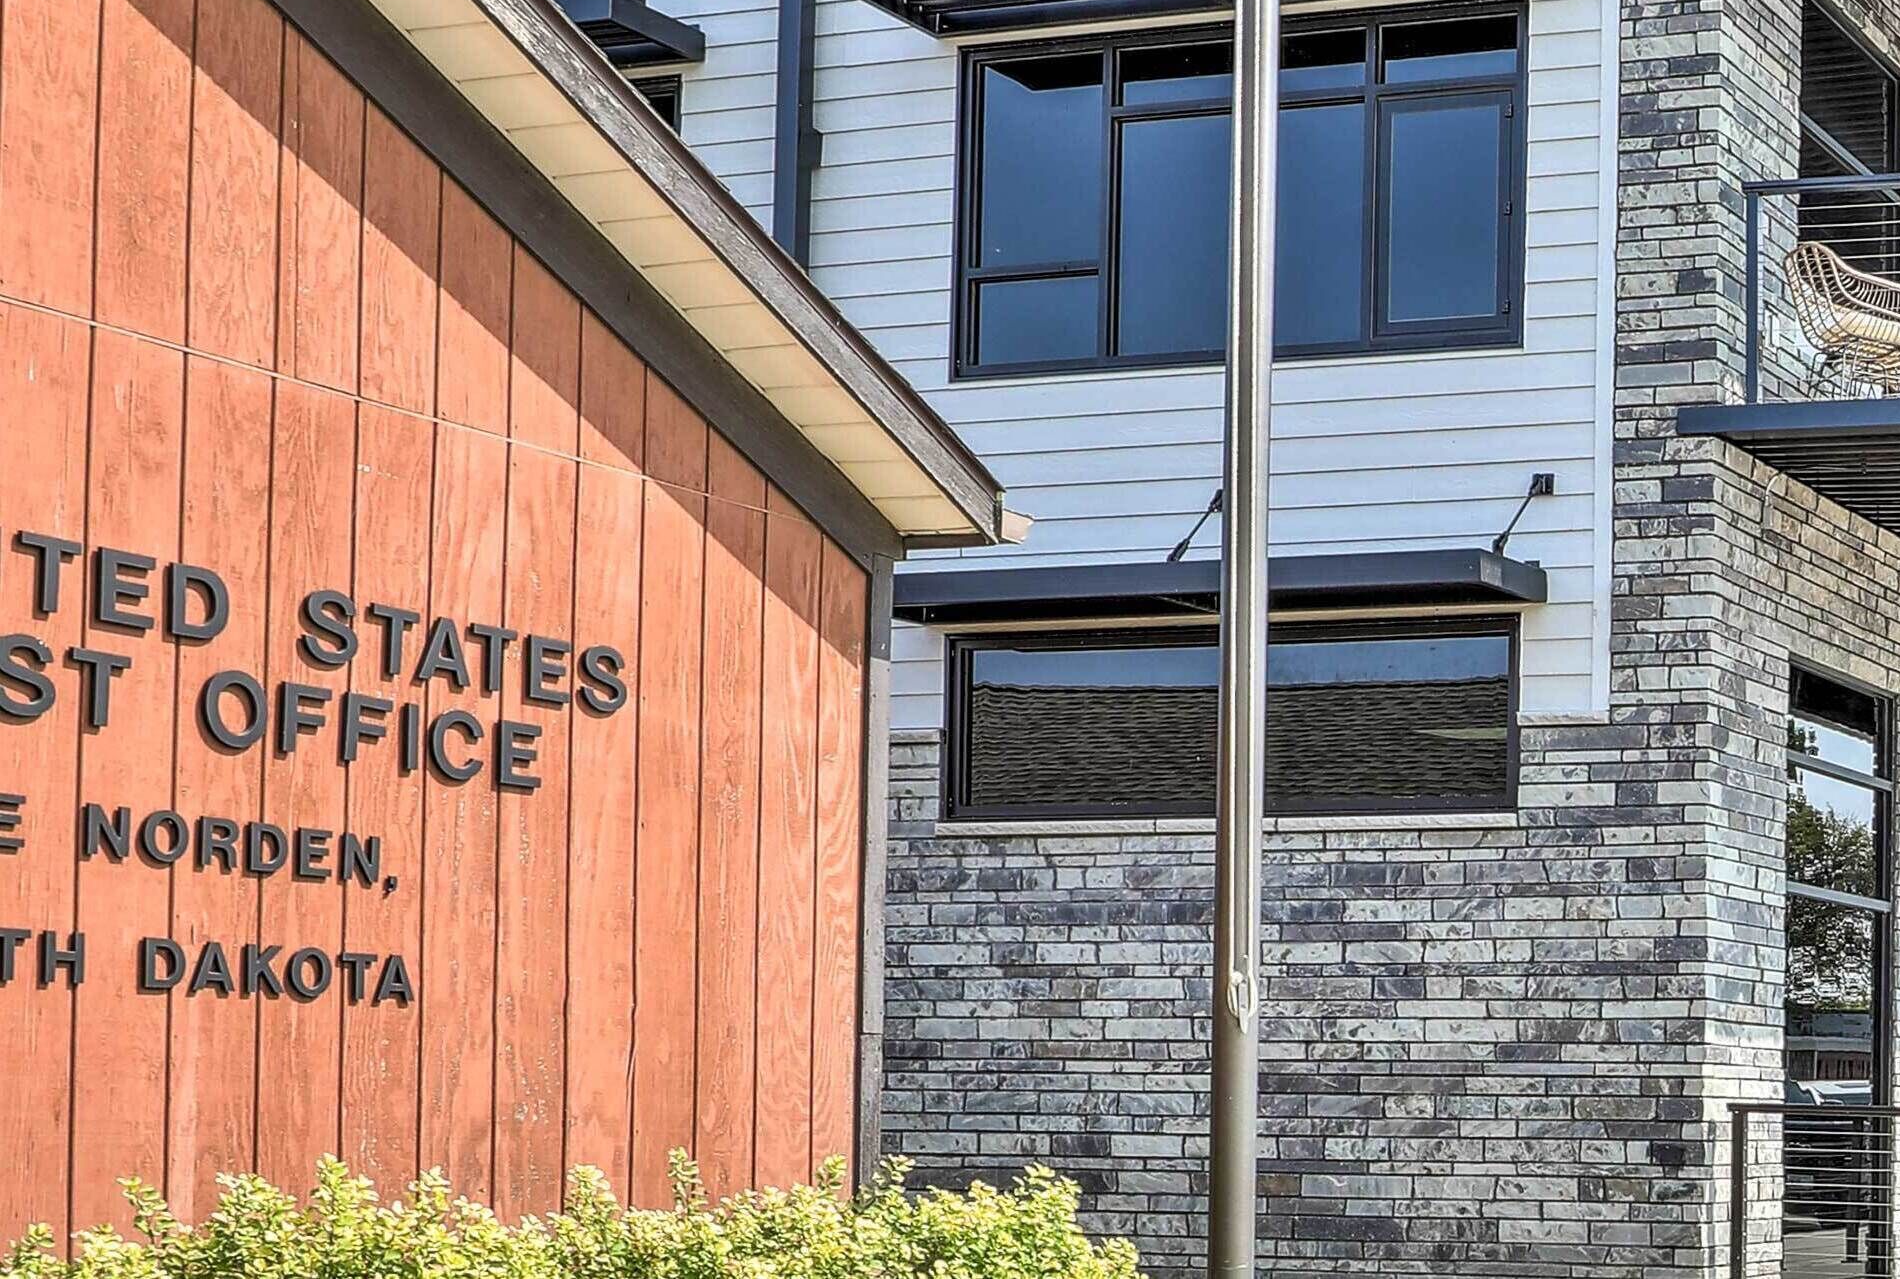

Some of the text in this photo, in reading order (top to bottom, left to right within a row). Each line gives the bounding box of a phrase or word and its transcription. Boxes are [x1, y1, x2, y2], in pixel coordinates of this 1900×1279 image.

[19, 531, 627, 713] TED STATES
[0, 634, 542, 789] ST OFFICE
[85, 803, 397, 894] NORDEN,
[144, 937, 413, 1001] DAKOTA
